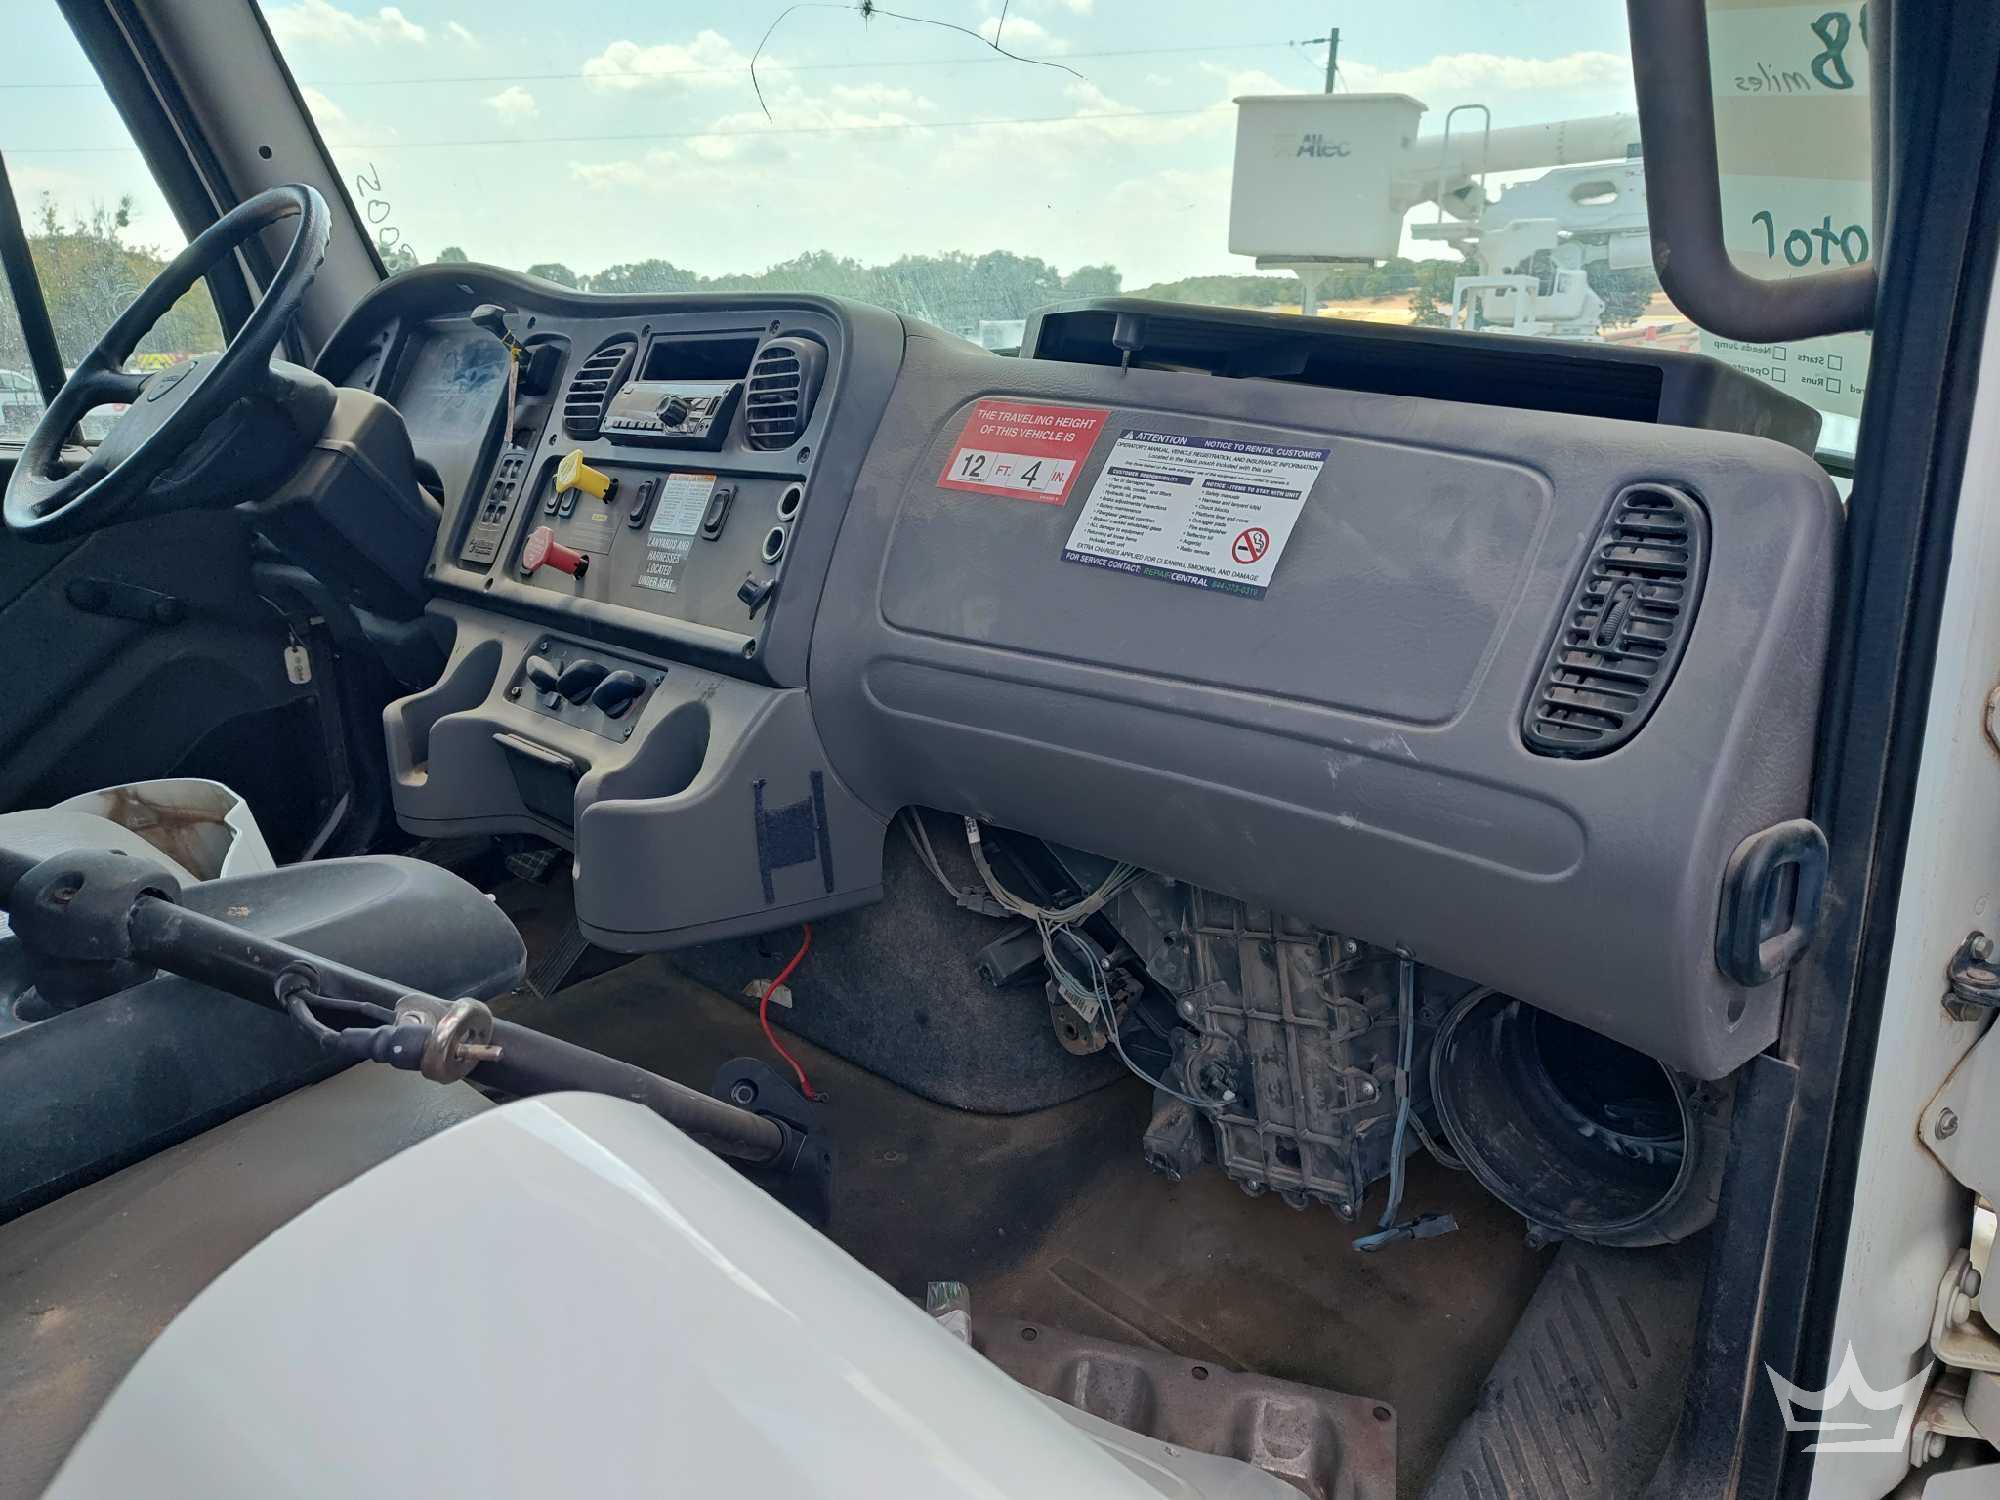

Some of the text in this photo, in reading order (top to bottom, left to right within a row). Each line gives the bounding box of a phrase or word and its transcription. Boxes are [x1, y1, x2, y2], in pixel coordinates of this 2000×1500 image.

[978, 409, 1096, 430] THE TRAVELING HEIGHT
[980, 425, 1076, 442] OF THIS VEHICLE IS
[1136, 433, 1322, 459] ATTENTION NOTICE TO RENTAL CUSTOMER
[960, 454, 1065, 487] 12 FT. 4 IN.
[1206, 481, 1225, 489] NOTICE
[647, 537, 677, 549] LANYARDS
[647, 551, 680, 563] HARNESSES
[1065, 552, 1080, 560] FOR
[1080, 555, 1108, 566] SERVICE
[1076, 542, 1094, 551] EXTRA
[1120, 551, 1144, 560] APPLIED
[1217, 569, 1231, 577] AND
[1231, 571, 1260, 581] DAMAGE
[646, 563, 672, 575] LOCATED
[638, 575, 674, 589] UNDER SEAT
